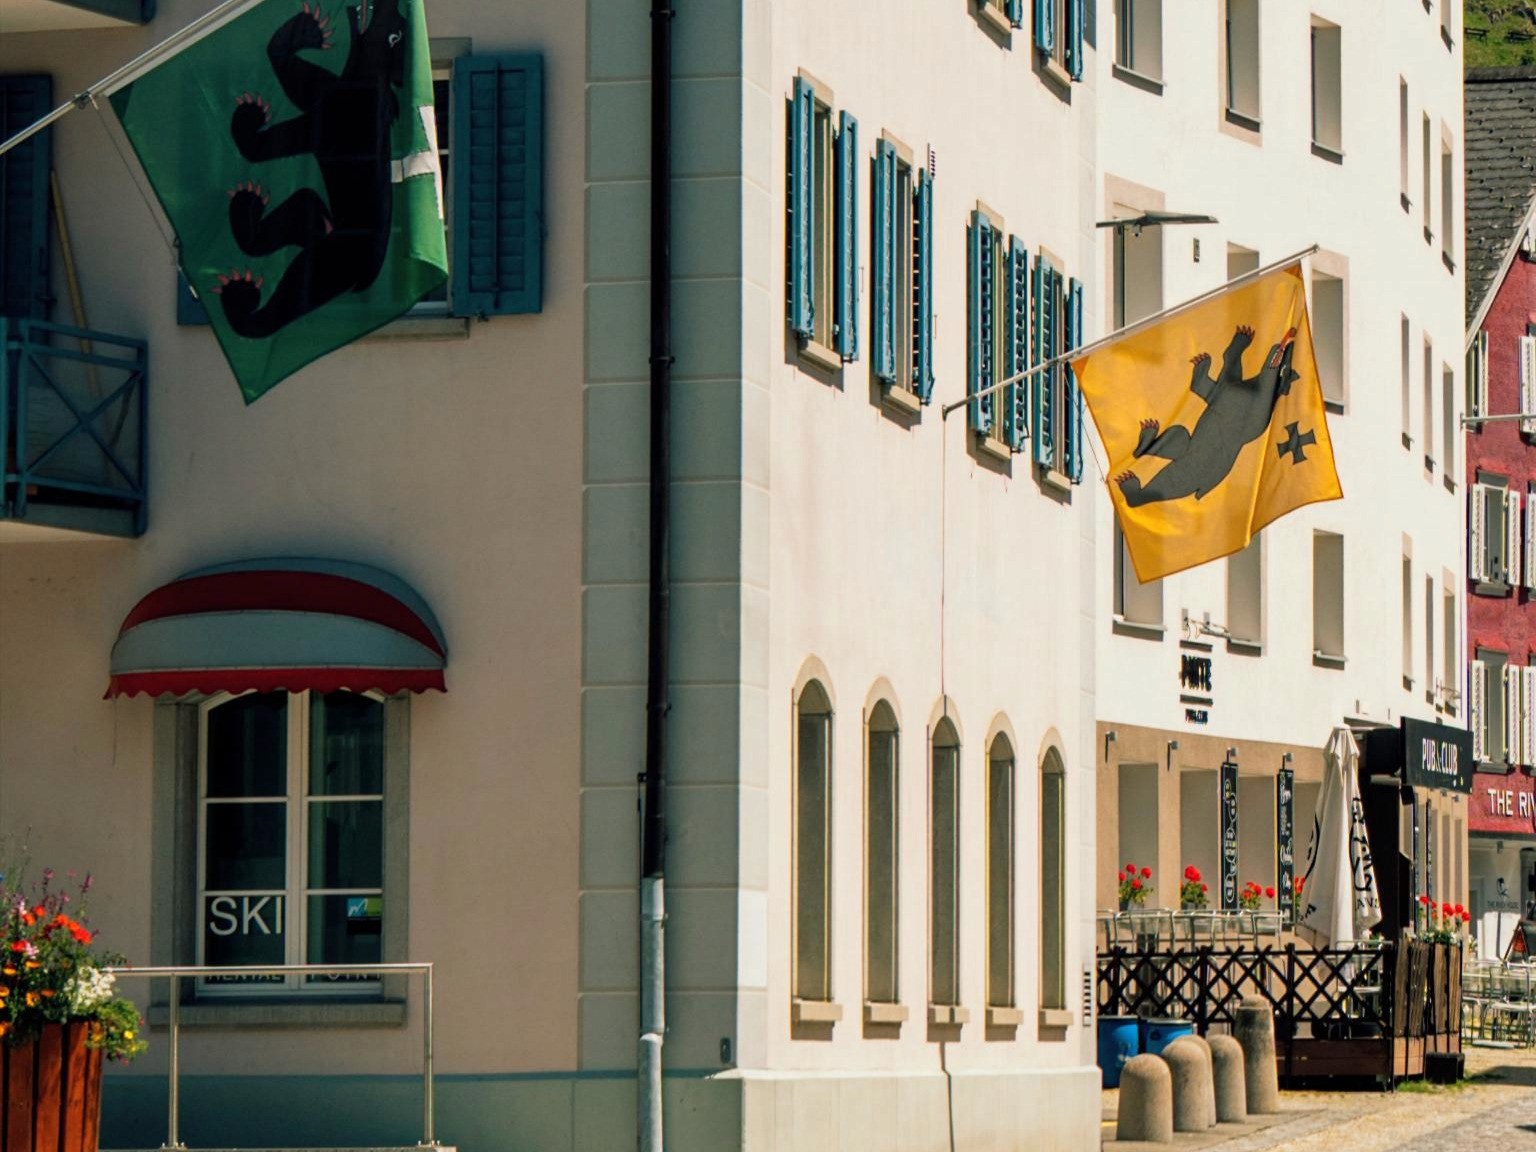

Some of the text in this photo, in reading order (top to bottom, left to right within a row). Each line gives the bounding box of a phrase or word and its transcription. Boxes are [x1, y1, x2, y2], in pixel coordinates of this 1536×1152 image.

[1422, 737, 1436, 771] PUB
[1442, 741, 1458, 776] CLUB
[1487, 789, 1514, 816] THE
[209, 896, 282, 936] SKI
